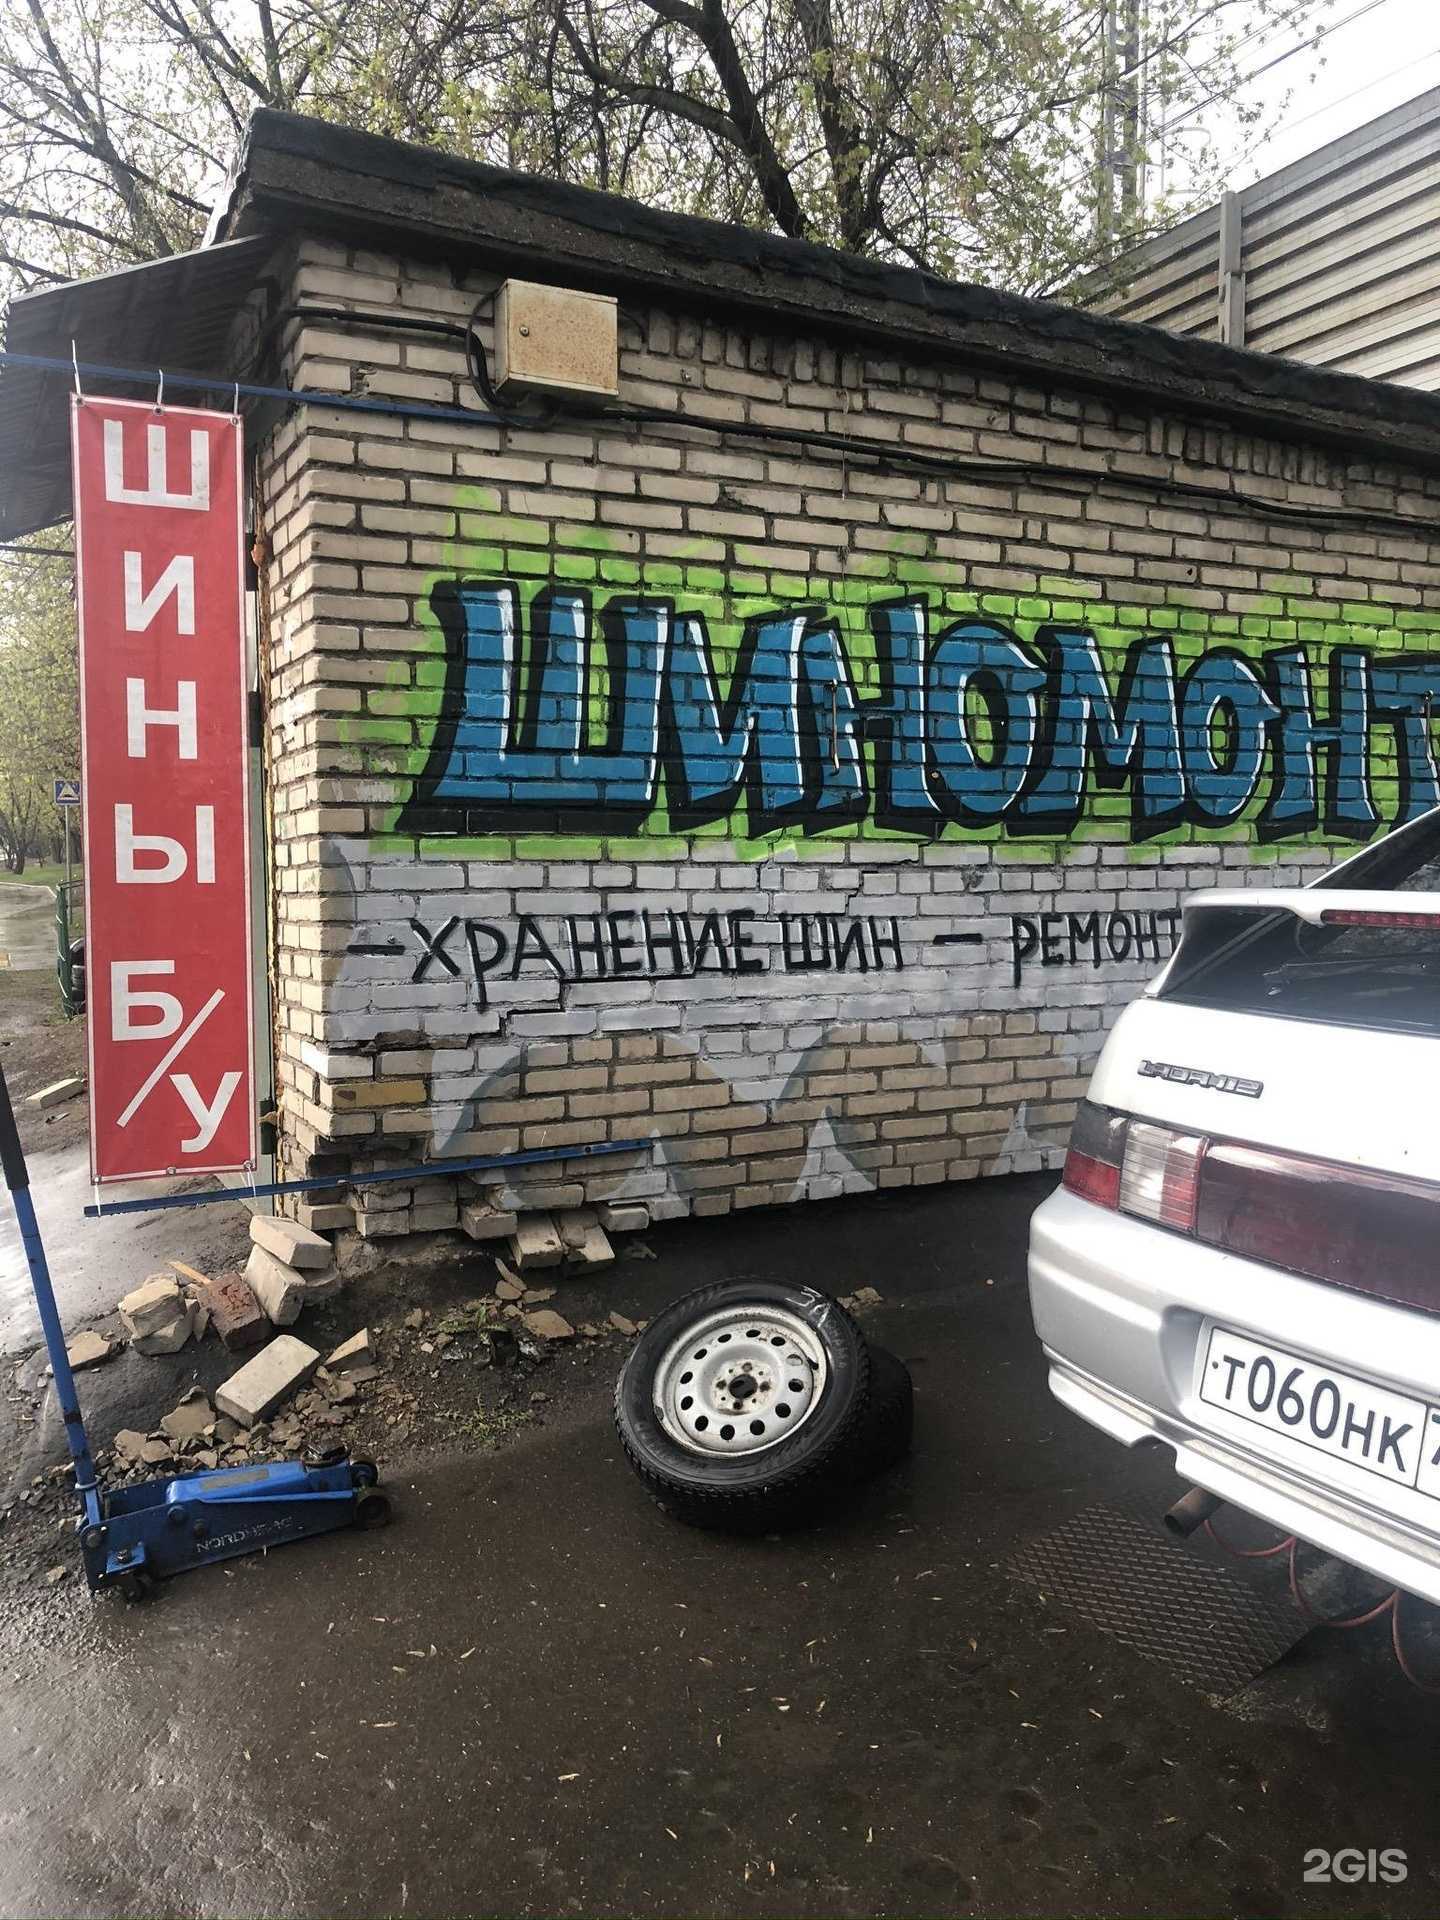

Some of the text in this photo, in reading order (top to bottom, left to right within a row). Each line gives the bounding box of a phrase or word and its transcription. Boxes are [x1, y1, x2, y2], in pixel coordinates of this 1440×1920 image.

[103, 417, 216, 885] ШИНЫ
[110, 959, 243, 1153] Б/У
[410, 908, 764, 1014] ХРАНЕНИЕ
[778, 909, 903, 975] ШИН
